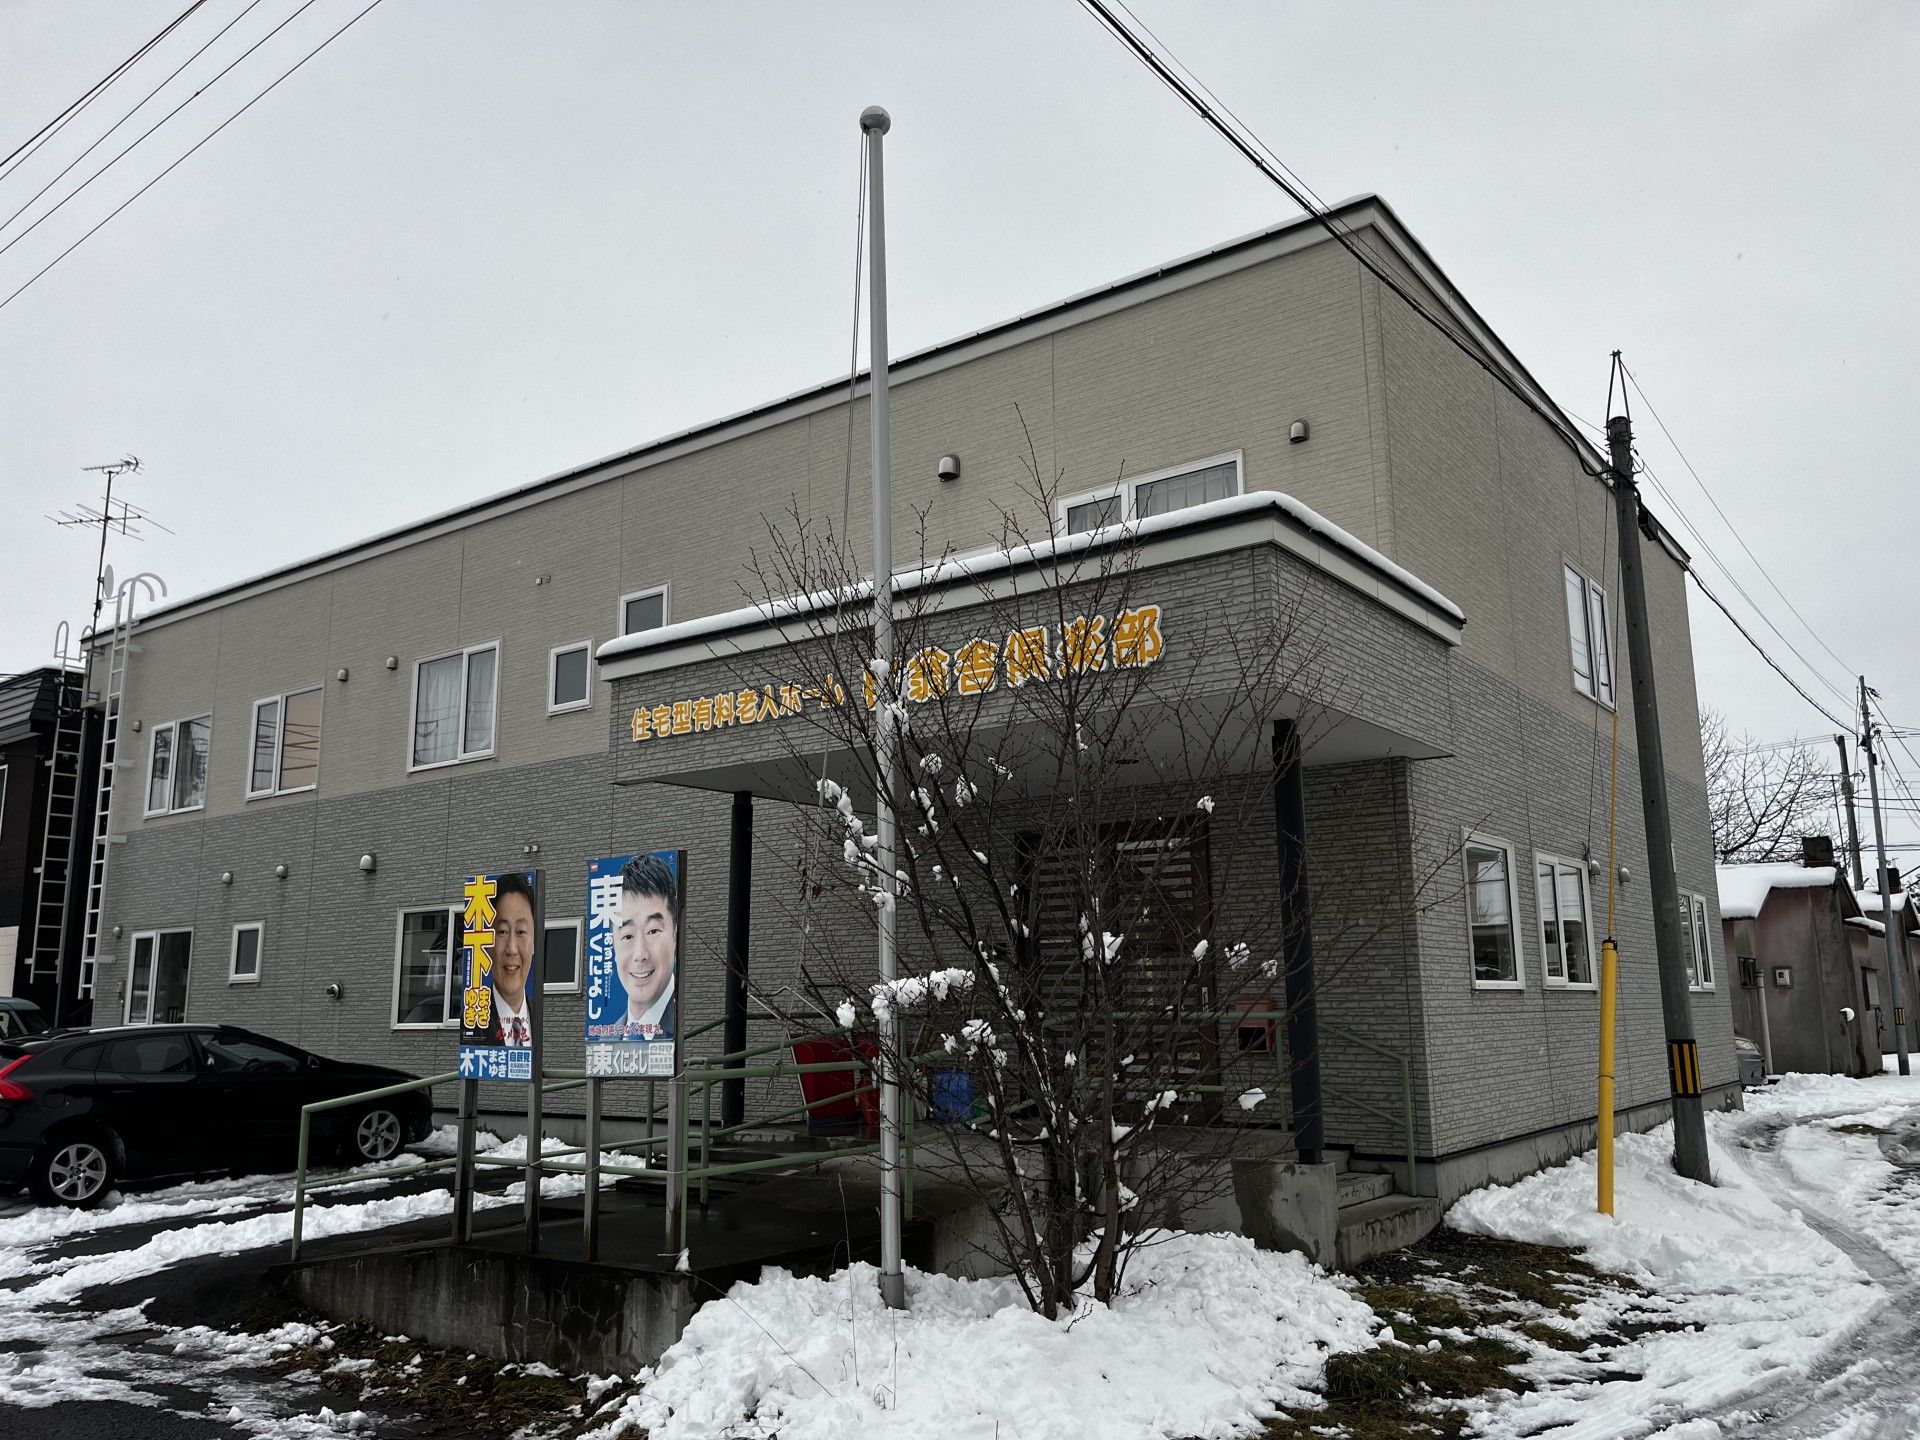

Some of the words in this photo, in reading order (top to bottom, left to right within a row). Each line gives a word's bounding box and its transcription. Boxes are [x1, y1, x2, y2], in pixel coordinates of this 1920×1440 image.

[464, 874, 497, 989] 木下
[460, 1048, 489, 1077] 木下
[509, 1051, 530, 1062] 自民党
[592, 1043, 648, 1075] 東くによし
